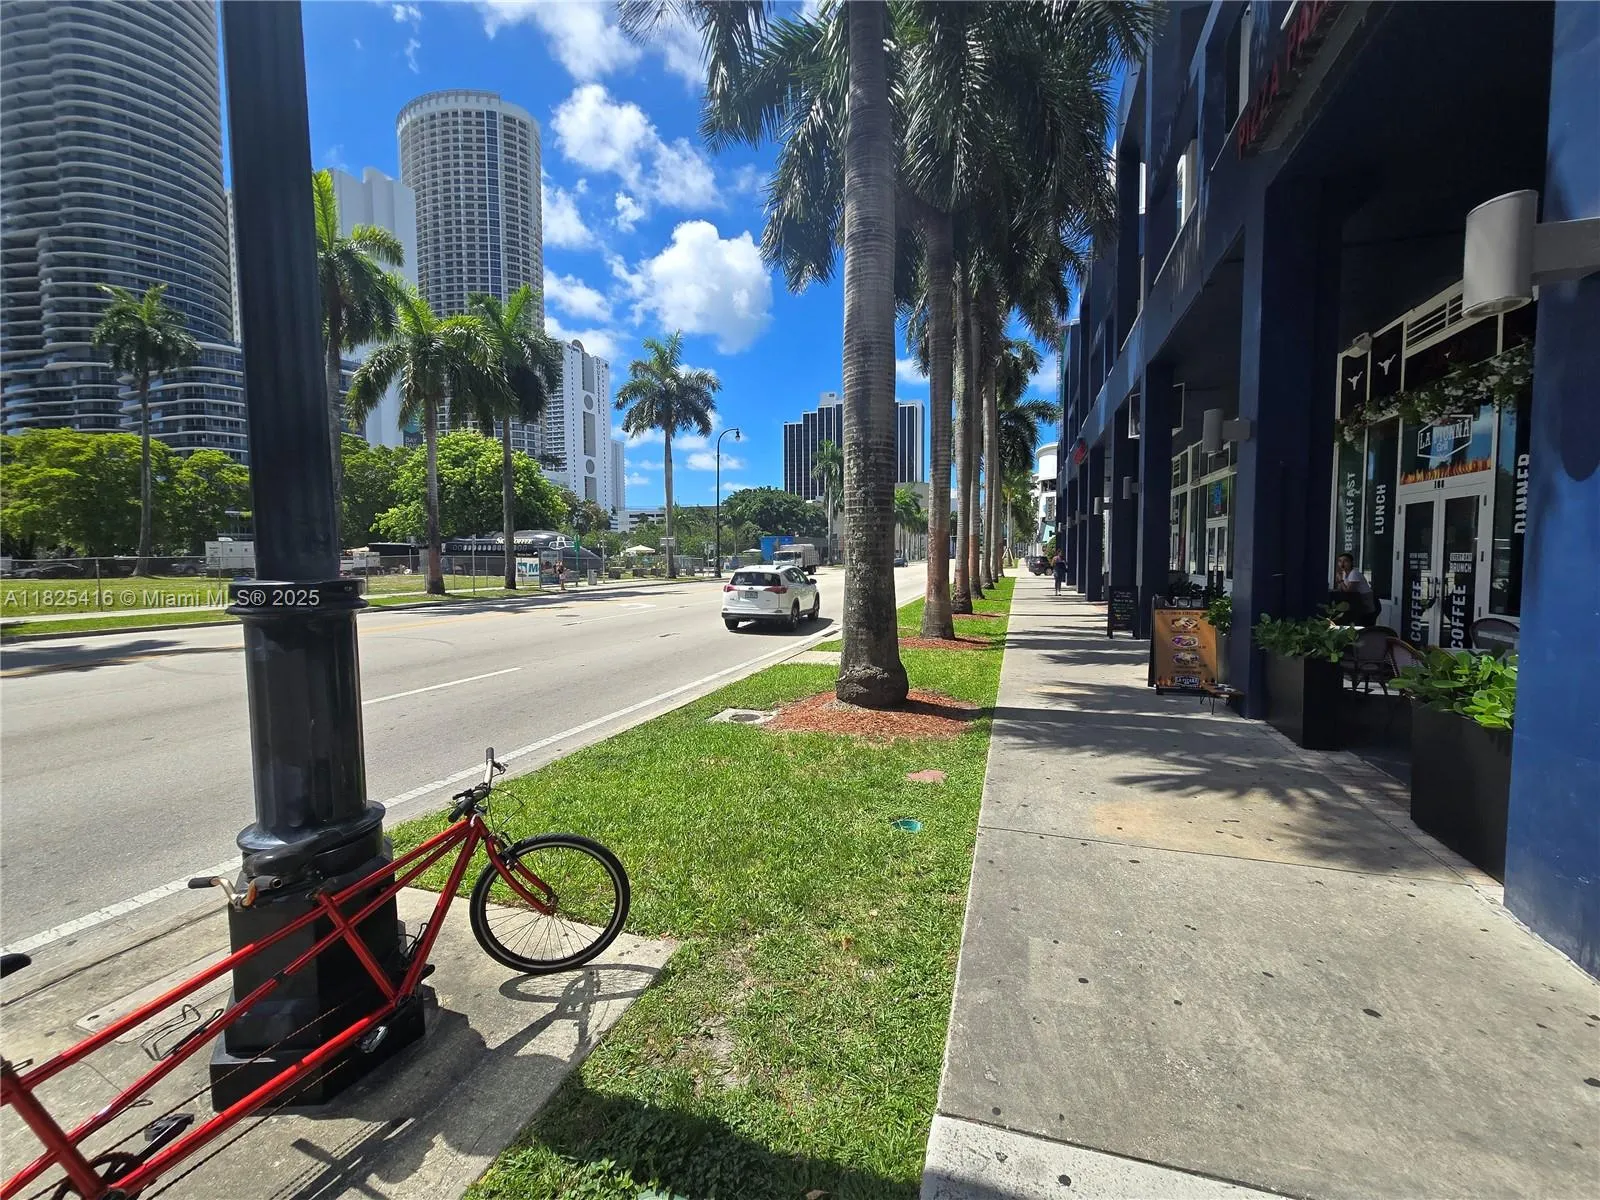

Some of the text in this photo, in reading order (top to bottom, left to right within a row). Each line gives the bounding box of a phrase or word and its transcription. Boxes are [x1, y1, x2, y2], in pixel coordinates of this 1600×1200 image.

[1420, 432, 1431, 449] LA
[1344, 472, 1356, 551] BREAKFAST
[1374, 484, 1386, 535] LUNCH
[1514, 454, 1530, 533] DINNER
[513, 537, 533, 545] OFFEE
[1450, 562, 1472, 573] BRUNCH
[1410, 580, 1422, 642] COFFEE
[1451, 585, 1466, 649] COFFEE
